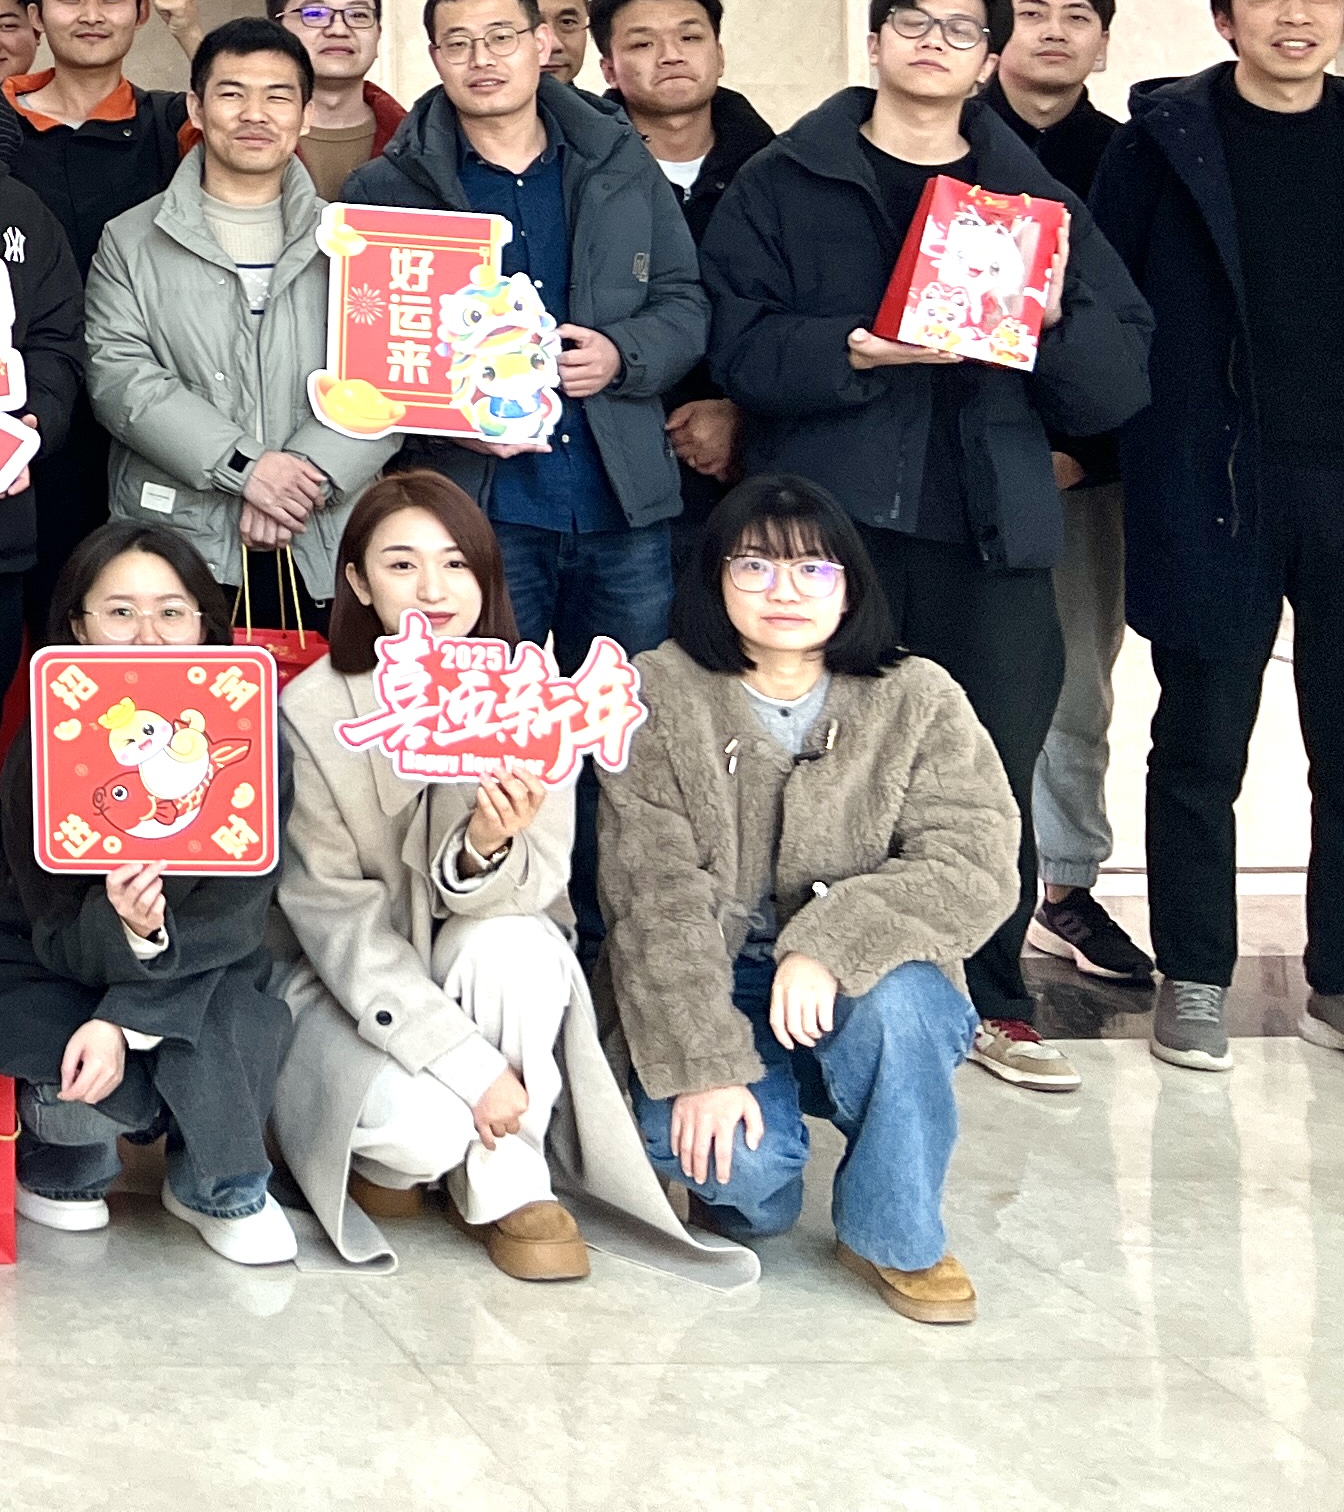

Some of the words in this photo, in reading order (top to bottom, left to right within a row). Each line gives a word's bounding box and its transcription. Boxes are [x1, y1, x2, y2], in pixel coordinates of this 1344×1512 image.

[387, 246, 434, 385] 好运来
[440, 643, 503, 670] 2025
[50, 664, 99, 711] 招
[209, 665, 260, 712] 宝
[402, 750, 459, 775] Happy
[461, 752, 502, 774] New
